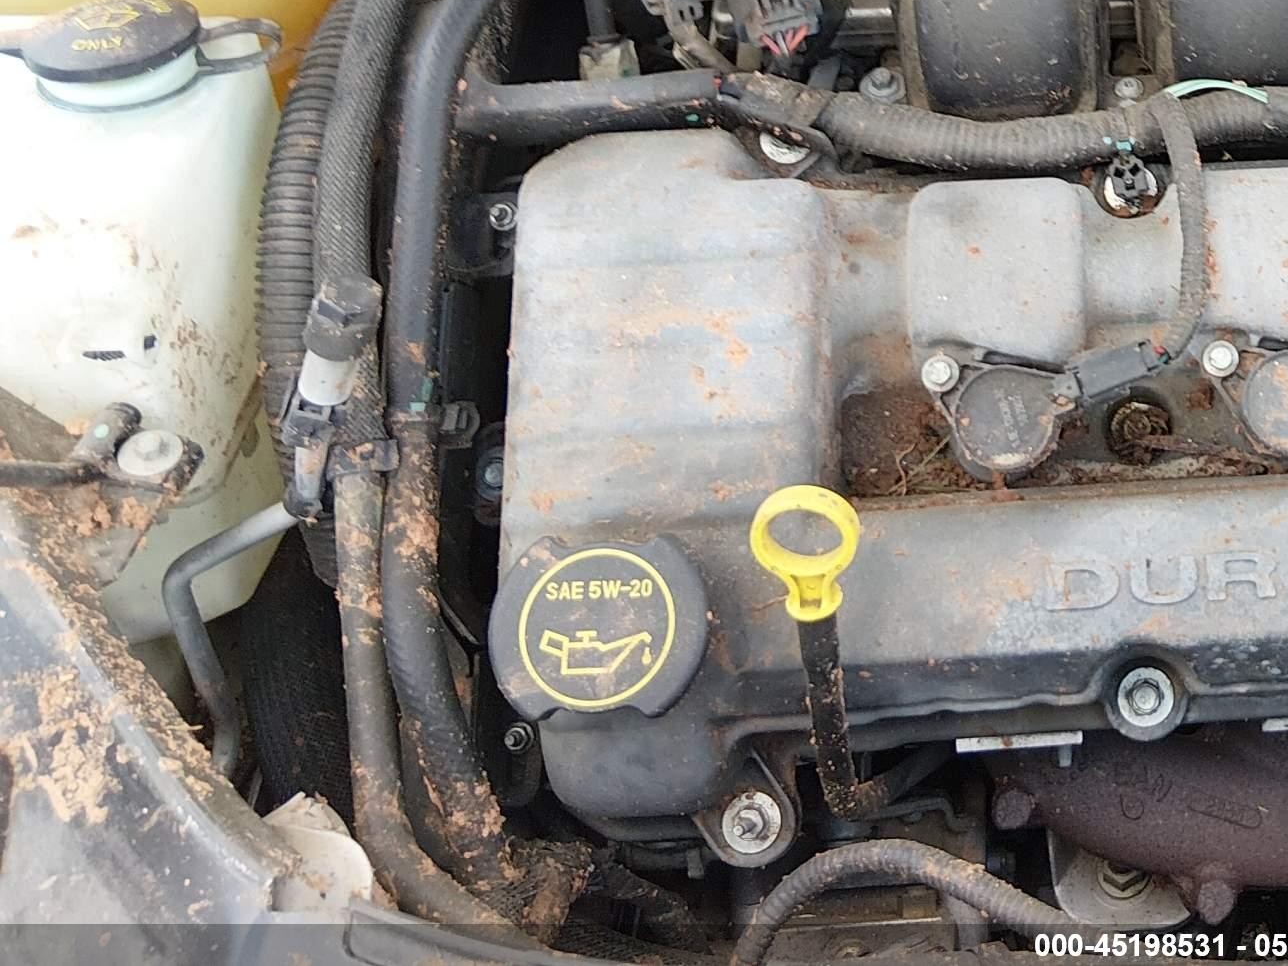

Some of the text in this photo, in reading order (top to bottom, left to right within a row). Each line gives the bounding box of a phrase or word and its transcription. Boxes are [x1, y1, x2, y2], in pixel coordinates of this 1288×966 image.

[71, 36, 123, 51] ONLY
[545, 579, 653, 600] SAE 5W-20
